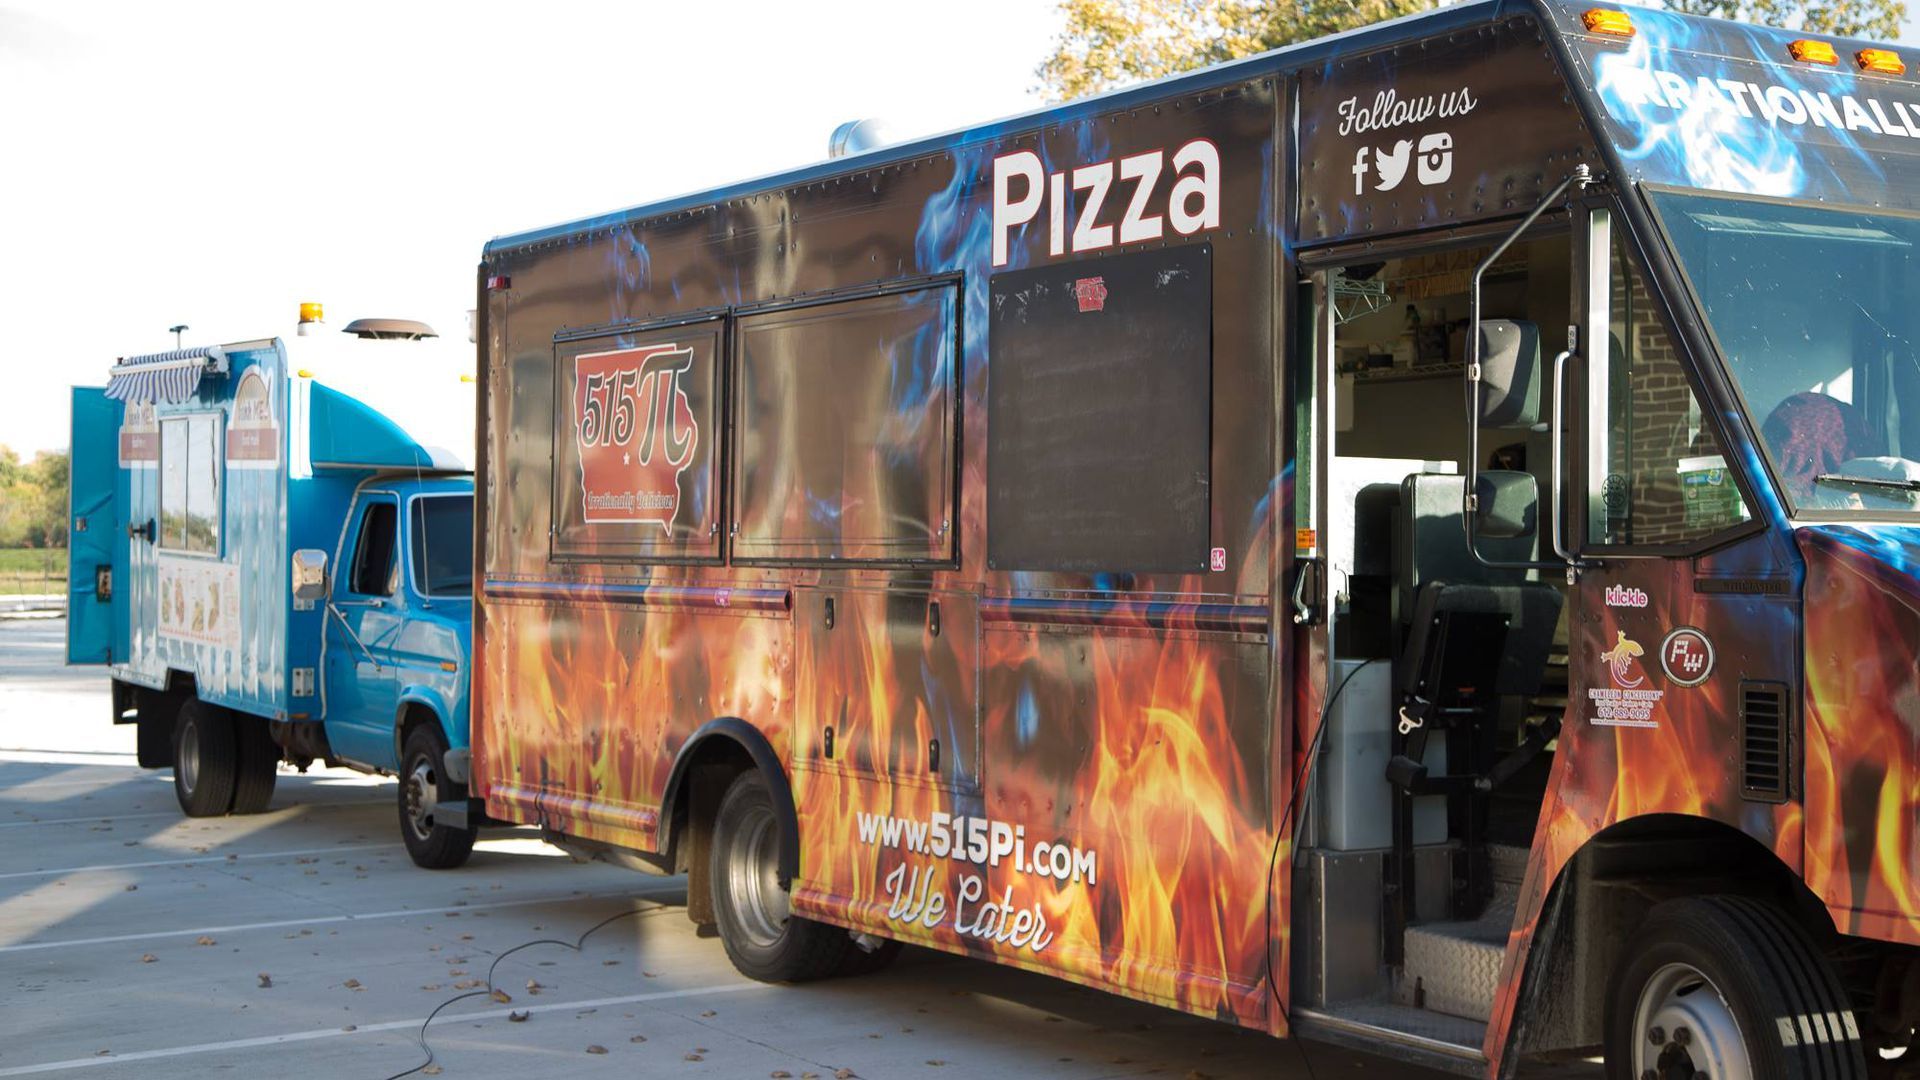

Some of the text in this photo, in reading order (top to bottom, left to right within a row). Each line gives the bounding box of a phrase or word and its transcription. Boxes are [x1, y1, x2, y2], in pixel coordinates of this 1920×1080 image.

[1338, 86, 1478, 136] Follow us
[991, 137, 1221, 268] Pizza
[1606, 584, 1649, 607] klickle
[885, 862, 1054, 952] We Cater
